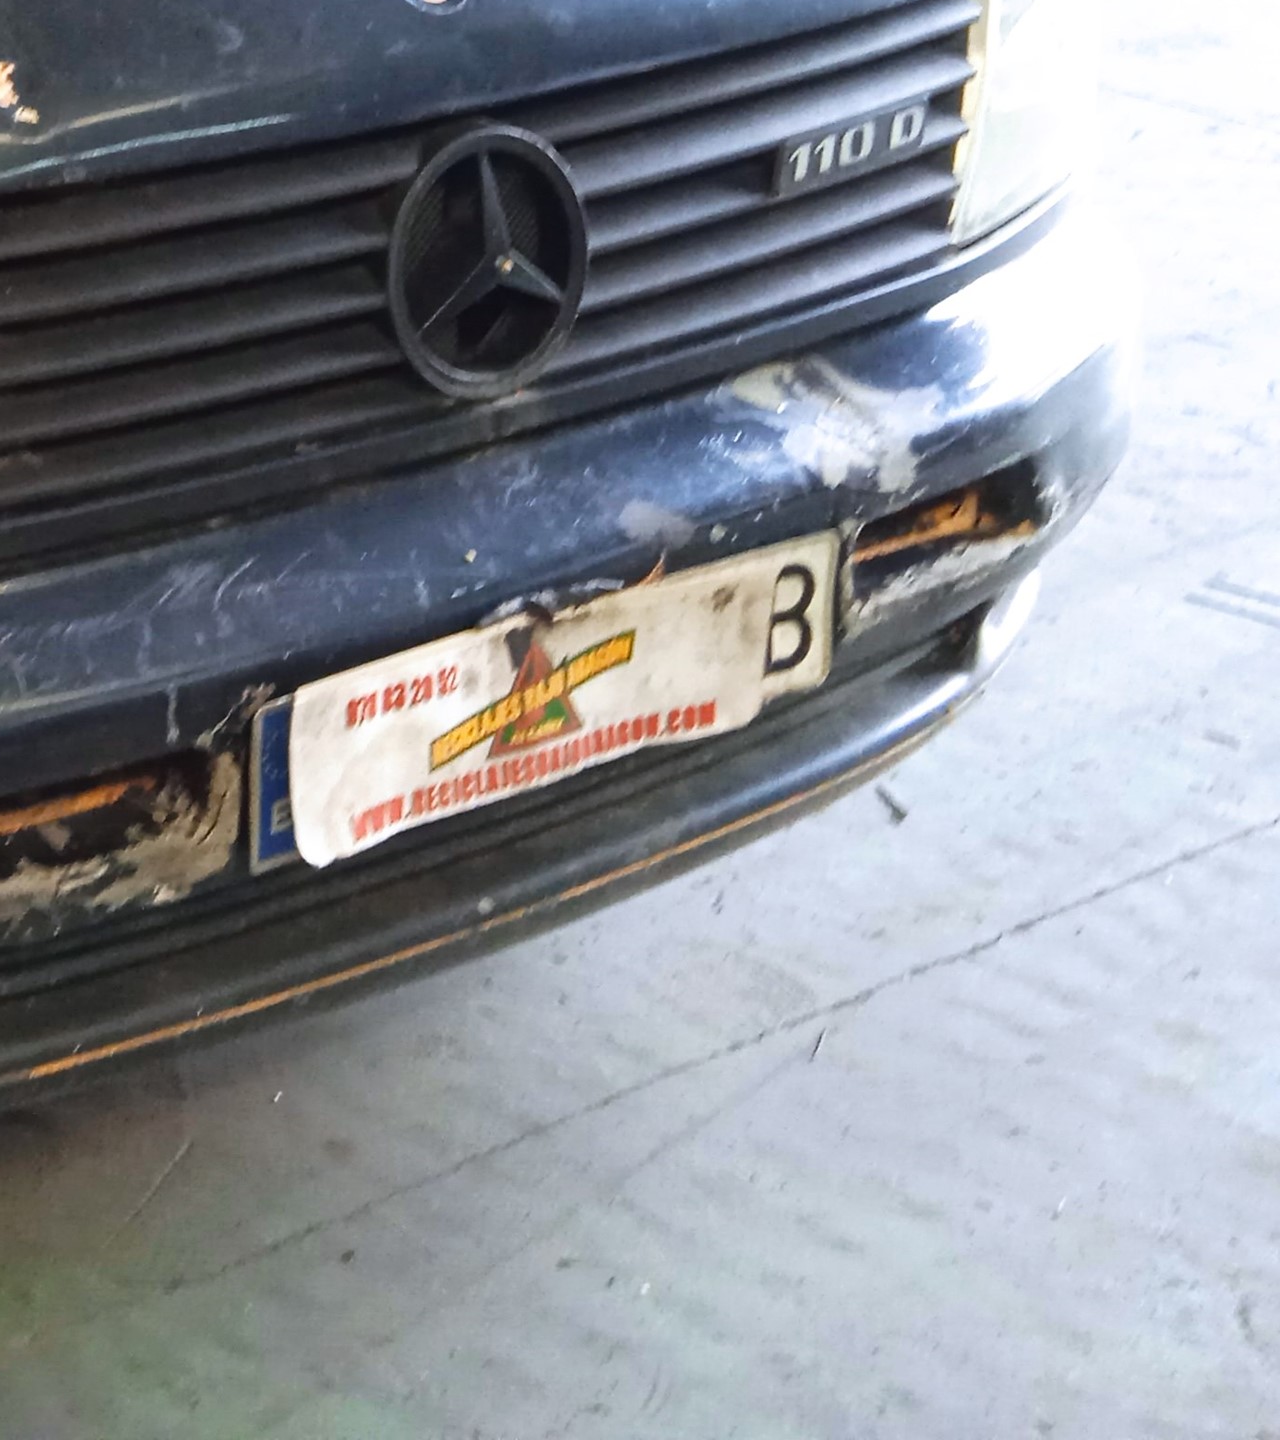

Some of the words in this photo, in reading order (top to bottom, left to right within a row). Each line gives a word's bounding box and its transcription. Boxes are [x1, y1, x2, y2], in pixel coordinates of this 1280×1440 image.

[790, 120, 876, 182] 110
[890, 106, 925, 149] D
[762, 564, 815, 678] B
